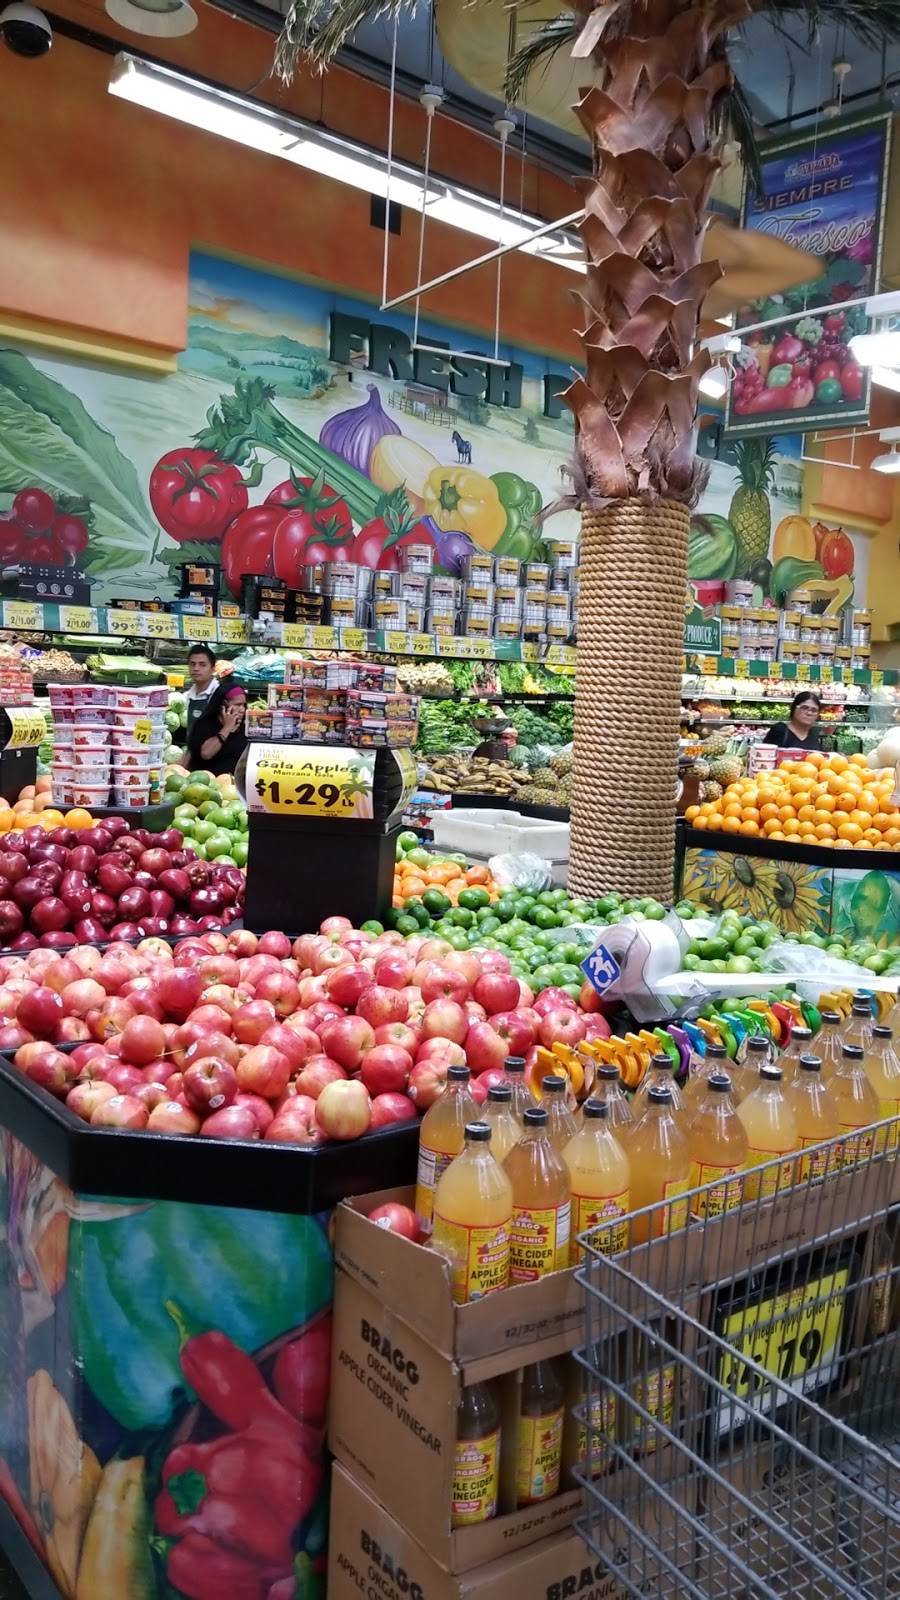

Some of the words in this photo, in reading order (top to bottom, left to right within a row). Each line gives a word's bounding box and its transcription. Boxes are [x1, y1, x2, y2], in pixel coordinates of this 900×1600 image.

[754, 175, 854, 213] SIEMPRE
[328, 312, 524, 408] FRESH
[687, 625, 713, 644] PRODUCE
[256, 759, 293, 770] Gala
[301, 762, 360, 774] Apples
[255, 778, 340, 808] $1.29
[525, 1248, 552, 1259] CIDER
[470, 1268, 498, 1280] APPLE
[360, 1319, 420, 1385] BRAGG
[367, 1353, 410, 1402] ORGANIC
[338, 1350, 366, 1385] APPLE
[366, 1372, 395, 1412] CIDER
[396, 1402, 442, 1456] VINEGAR
[470, 1474, 494, 1490] CIDER
[337, 1552, 367, 1594] APPLE
